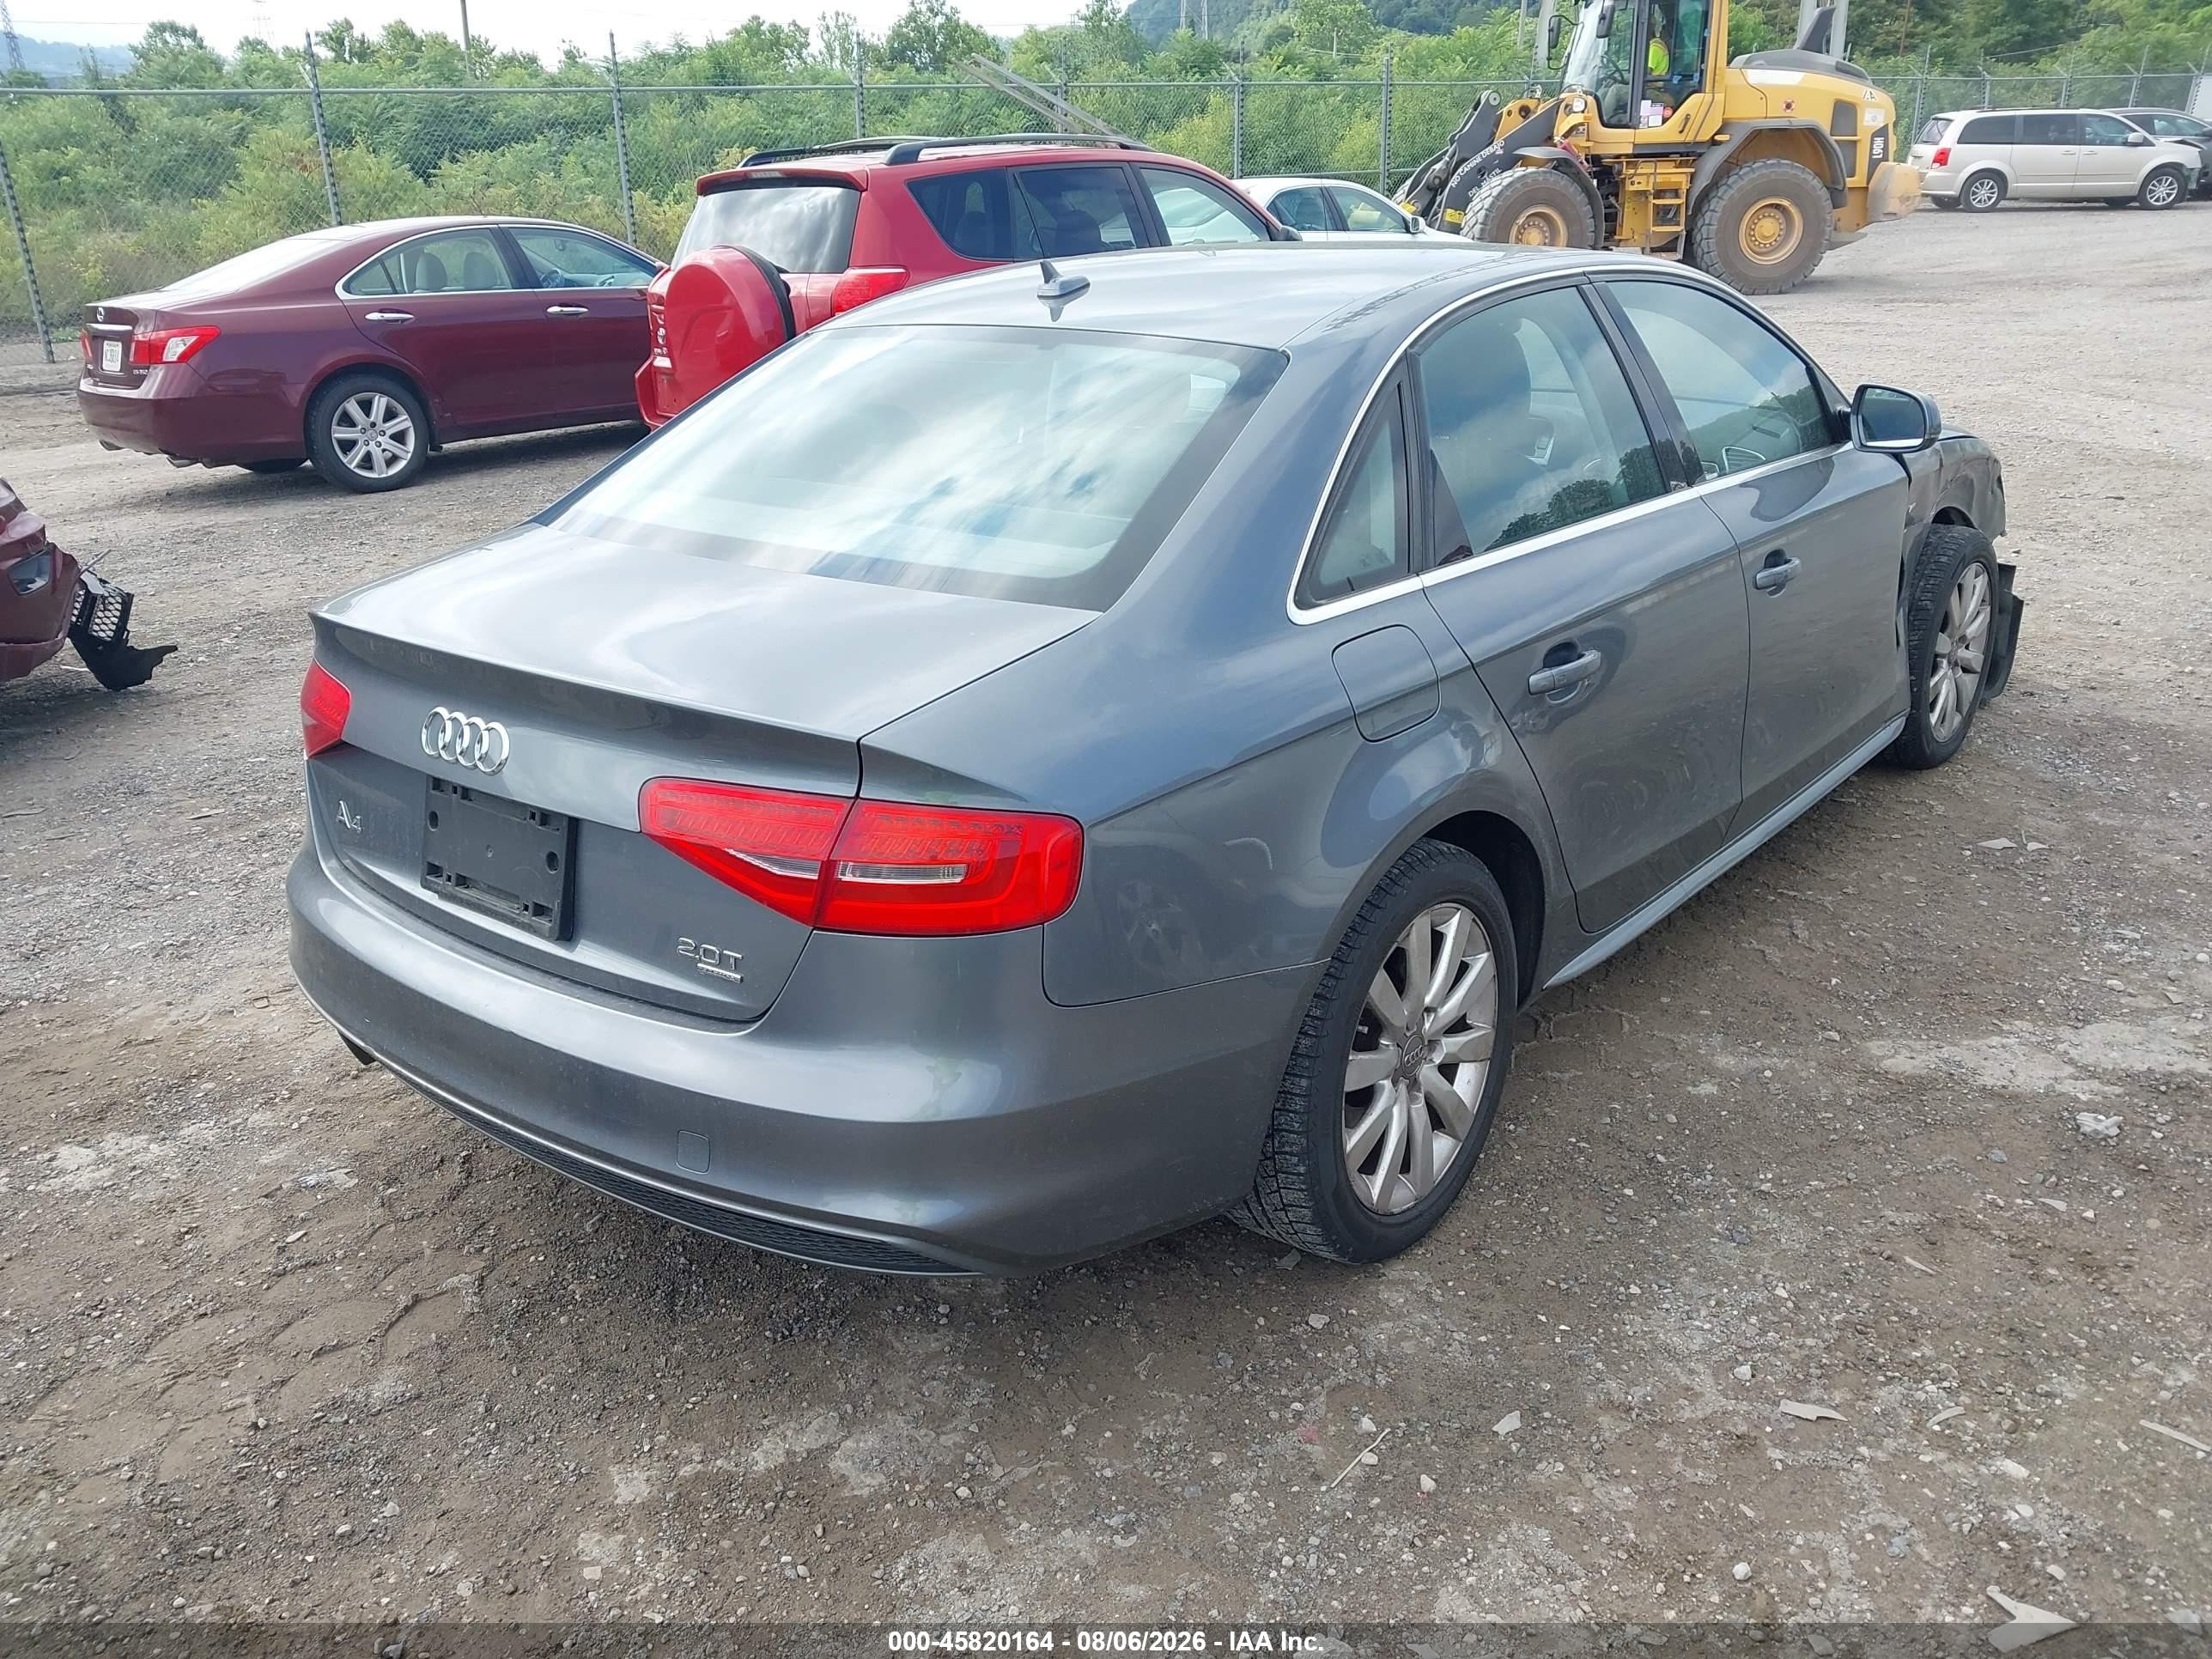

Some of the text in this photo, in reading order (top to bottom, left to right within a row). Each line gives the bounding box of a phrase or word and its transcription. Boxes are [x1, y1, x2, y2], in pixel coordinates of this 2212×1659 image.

[1872, 137, 1885, 159] L90H
[1451, 176, 1461, 187] NO
[1460, 156, 1483, 175] CAMINE
[1468, 186, 1480, 197] DEL
[336, 799, 362, 834] A4
[676, 936, 744, 971] 2.0T
